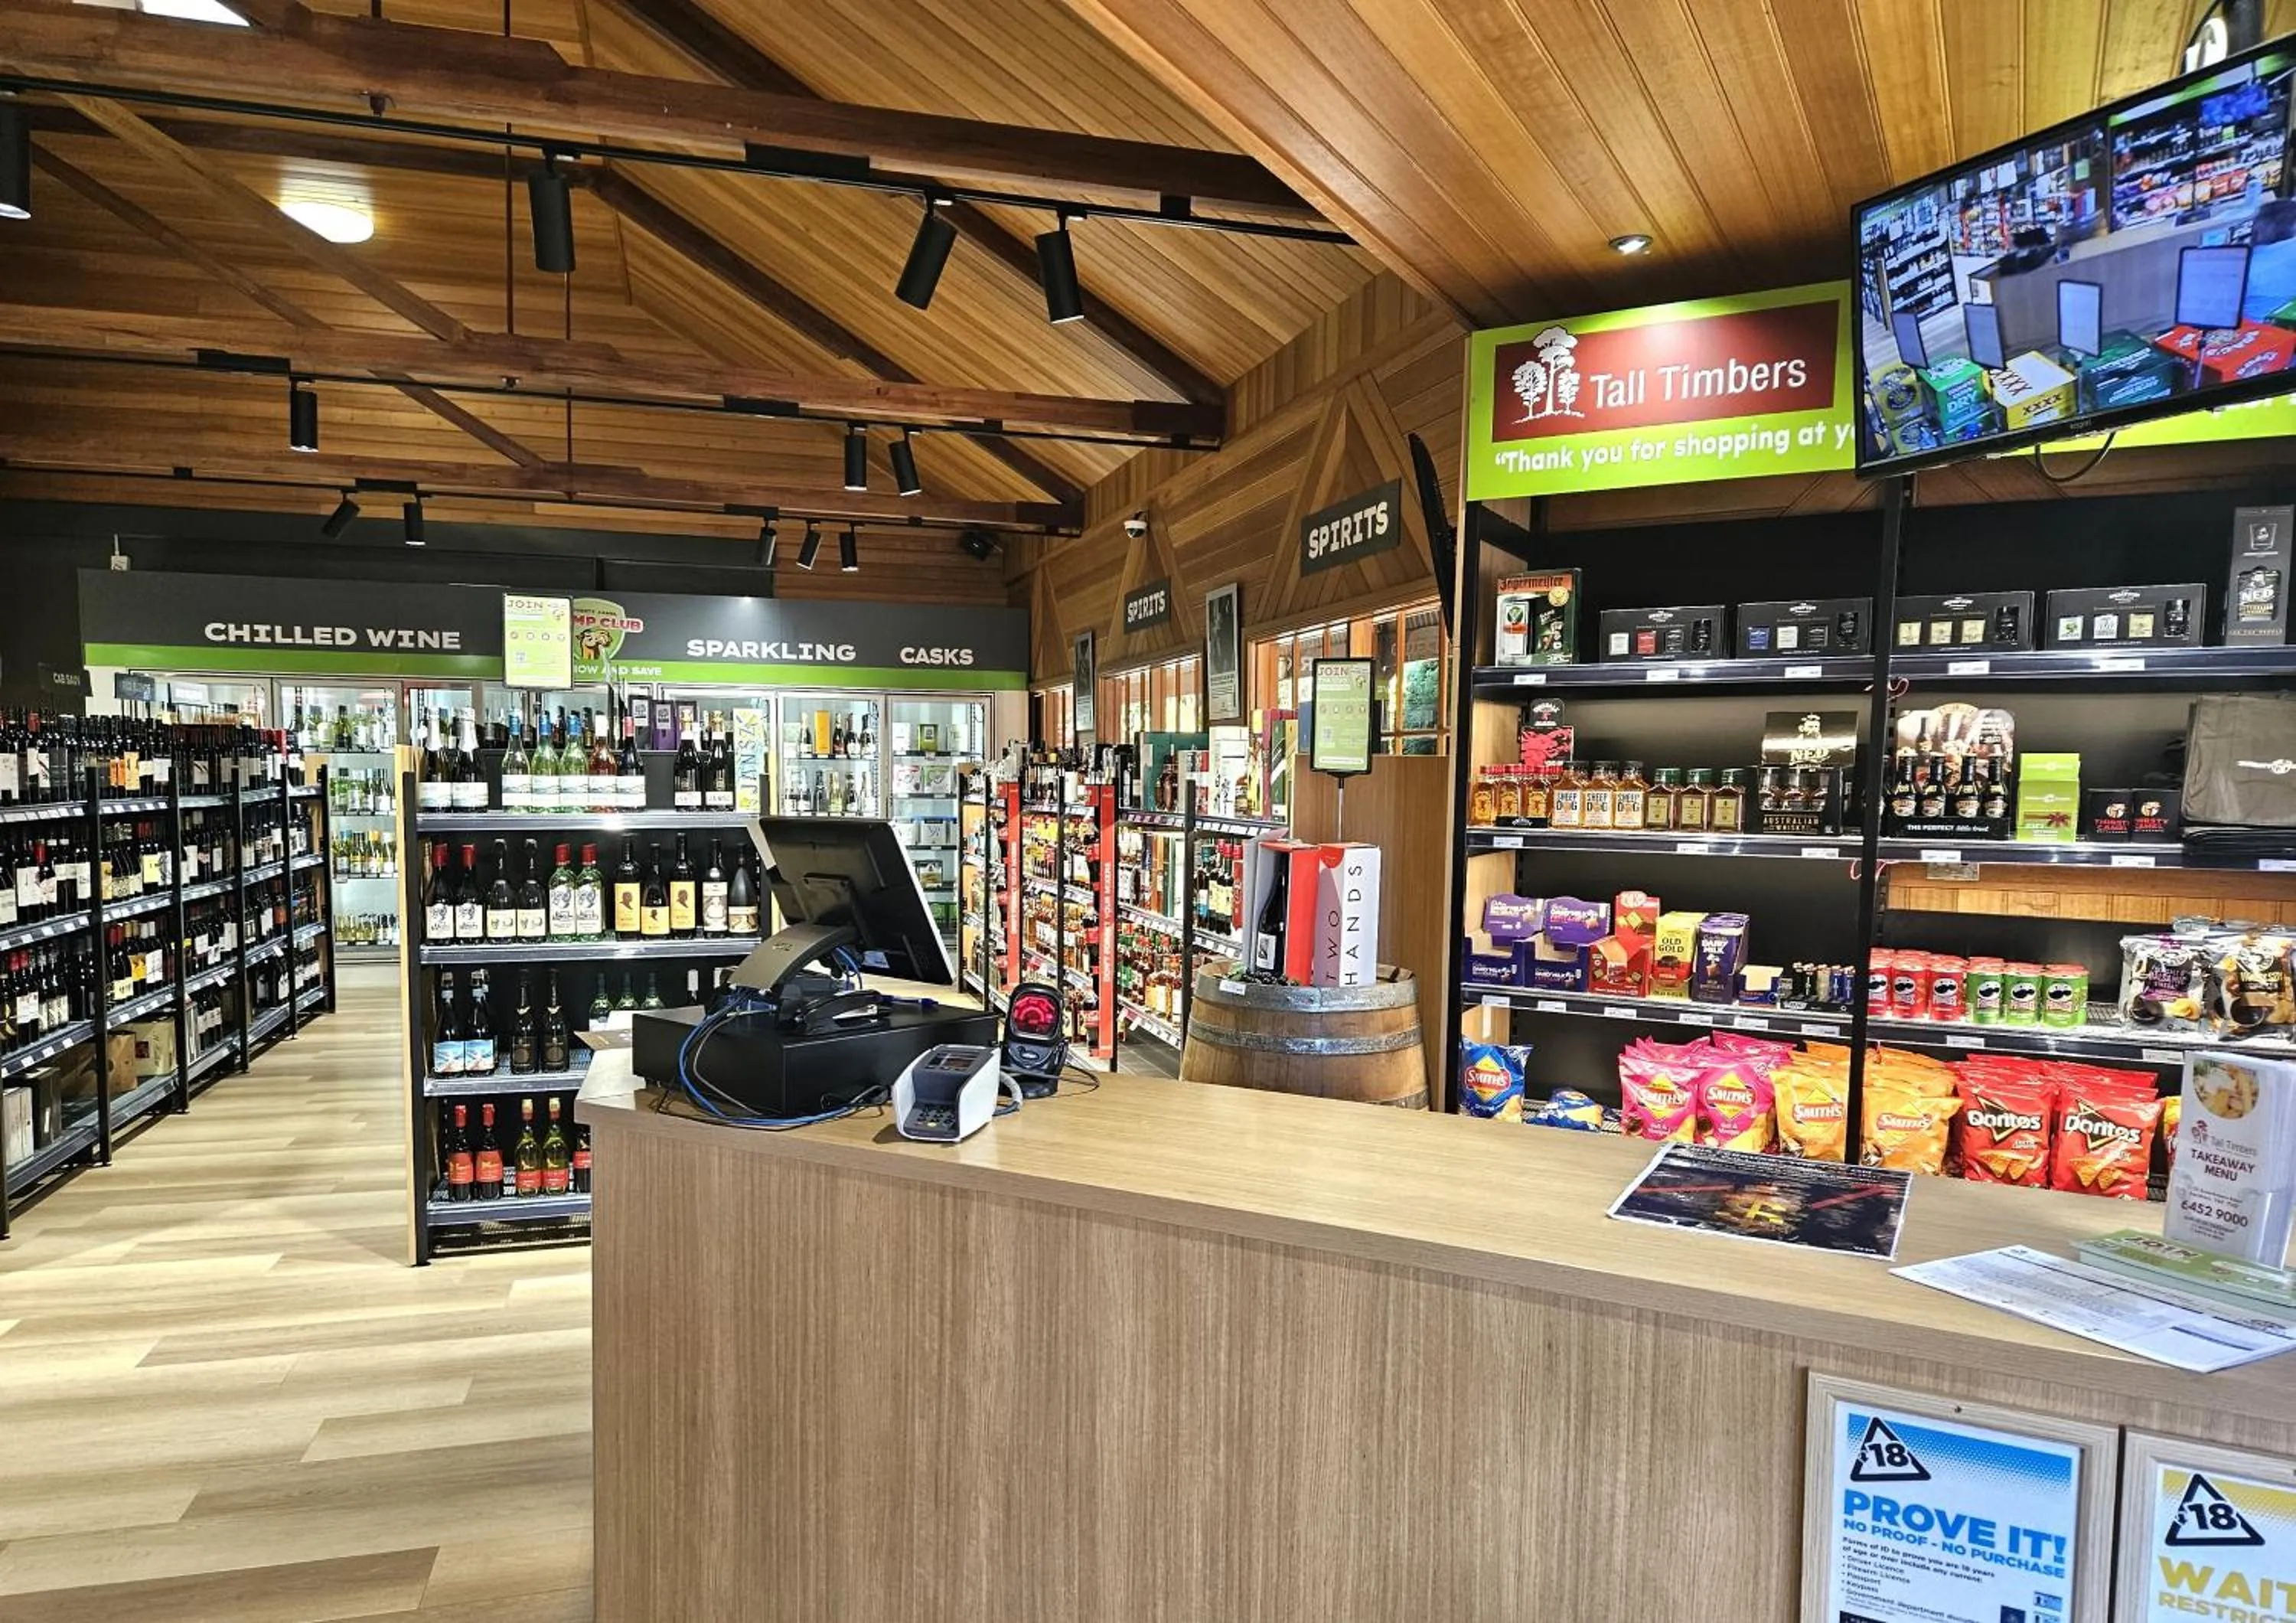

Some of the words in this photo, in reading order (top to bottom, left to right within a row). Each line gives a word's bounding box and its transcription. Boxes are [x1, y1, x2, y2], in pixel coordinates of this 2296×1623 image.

[1590, 370, 1645, 410] Tall
[1658, 358, 1806, 400] Timbers
[1582, 442, 1623, 474] you
[1630, 438, 1666, 460] for
[1674, 423, 1791, 459] shopping
[1799, 420, 1827, 446] at
[1308, 501, 1389, 560] SPIRITS
[507, 599, 543, 609] JOIN
[1127, 589, 1166, 623] SPIRITS
[204, 622, 357, 647] CHILLED
[366, 629, 461, 650] WINE
[599, 617, 641, 630] CLUB
[687, 639, 856, 661] SPARKLING
[899, 647, 974, 665] CASKS
[631, 667, 662, 676] SAVE
[1318, 667, 1348, 676] JOIN
[739, 727, 758, 795] JANSZ
[1790, 747, 1830, 763] NED
[1763, 816, 1819, 825] AUSTRALIAN
[1344, 865, 1363, 986] HANDS
[1326, 910, 1340, 981] TWO
[1658, 945, 1684, 954] GOLD
[1661, 936, 1681, 945] OLD
[1701, 939, 1729, 948] DAIRY
[1703, 946, 1725, 955] MILK
[1968, 1110, 2041, 1130] Doritos
[2064, 1115, 2141, 1144] Doritos
[2190, 1148, 2255, 1174] TAKEAWAY
[2204, 1164, 2238, 1181] MENU
[2180, 1200, 2213, 1217] 6452
[2216, 1209, 2249, 1227] 9000
[1867, 1442, 1910, 1468] 18
[1844, 1488, 1997, 1549] PROVE
[2007, 1524, 2066, 1564] IT!
[2187, 1503, 2238, 1530] 18
[1844, 1518, 1867, 1533] NO
[1871, 1524, 1928, 1547] PROOF
[1942, 1541, 1966, 1556] NO
[1971, 1549, 2066, 1579] PURCHASE
